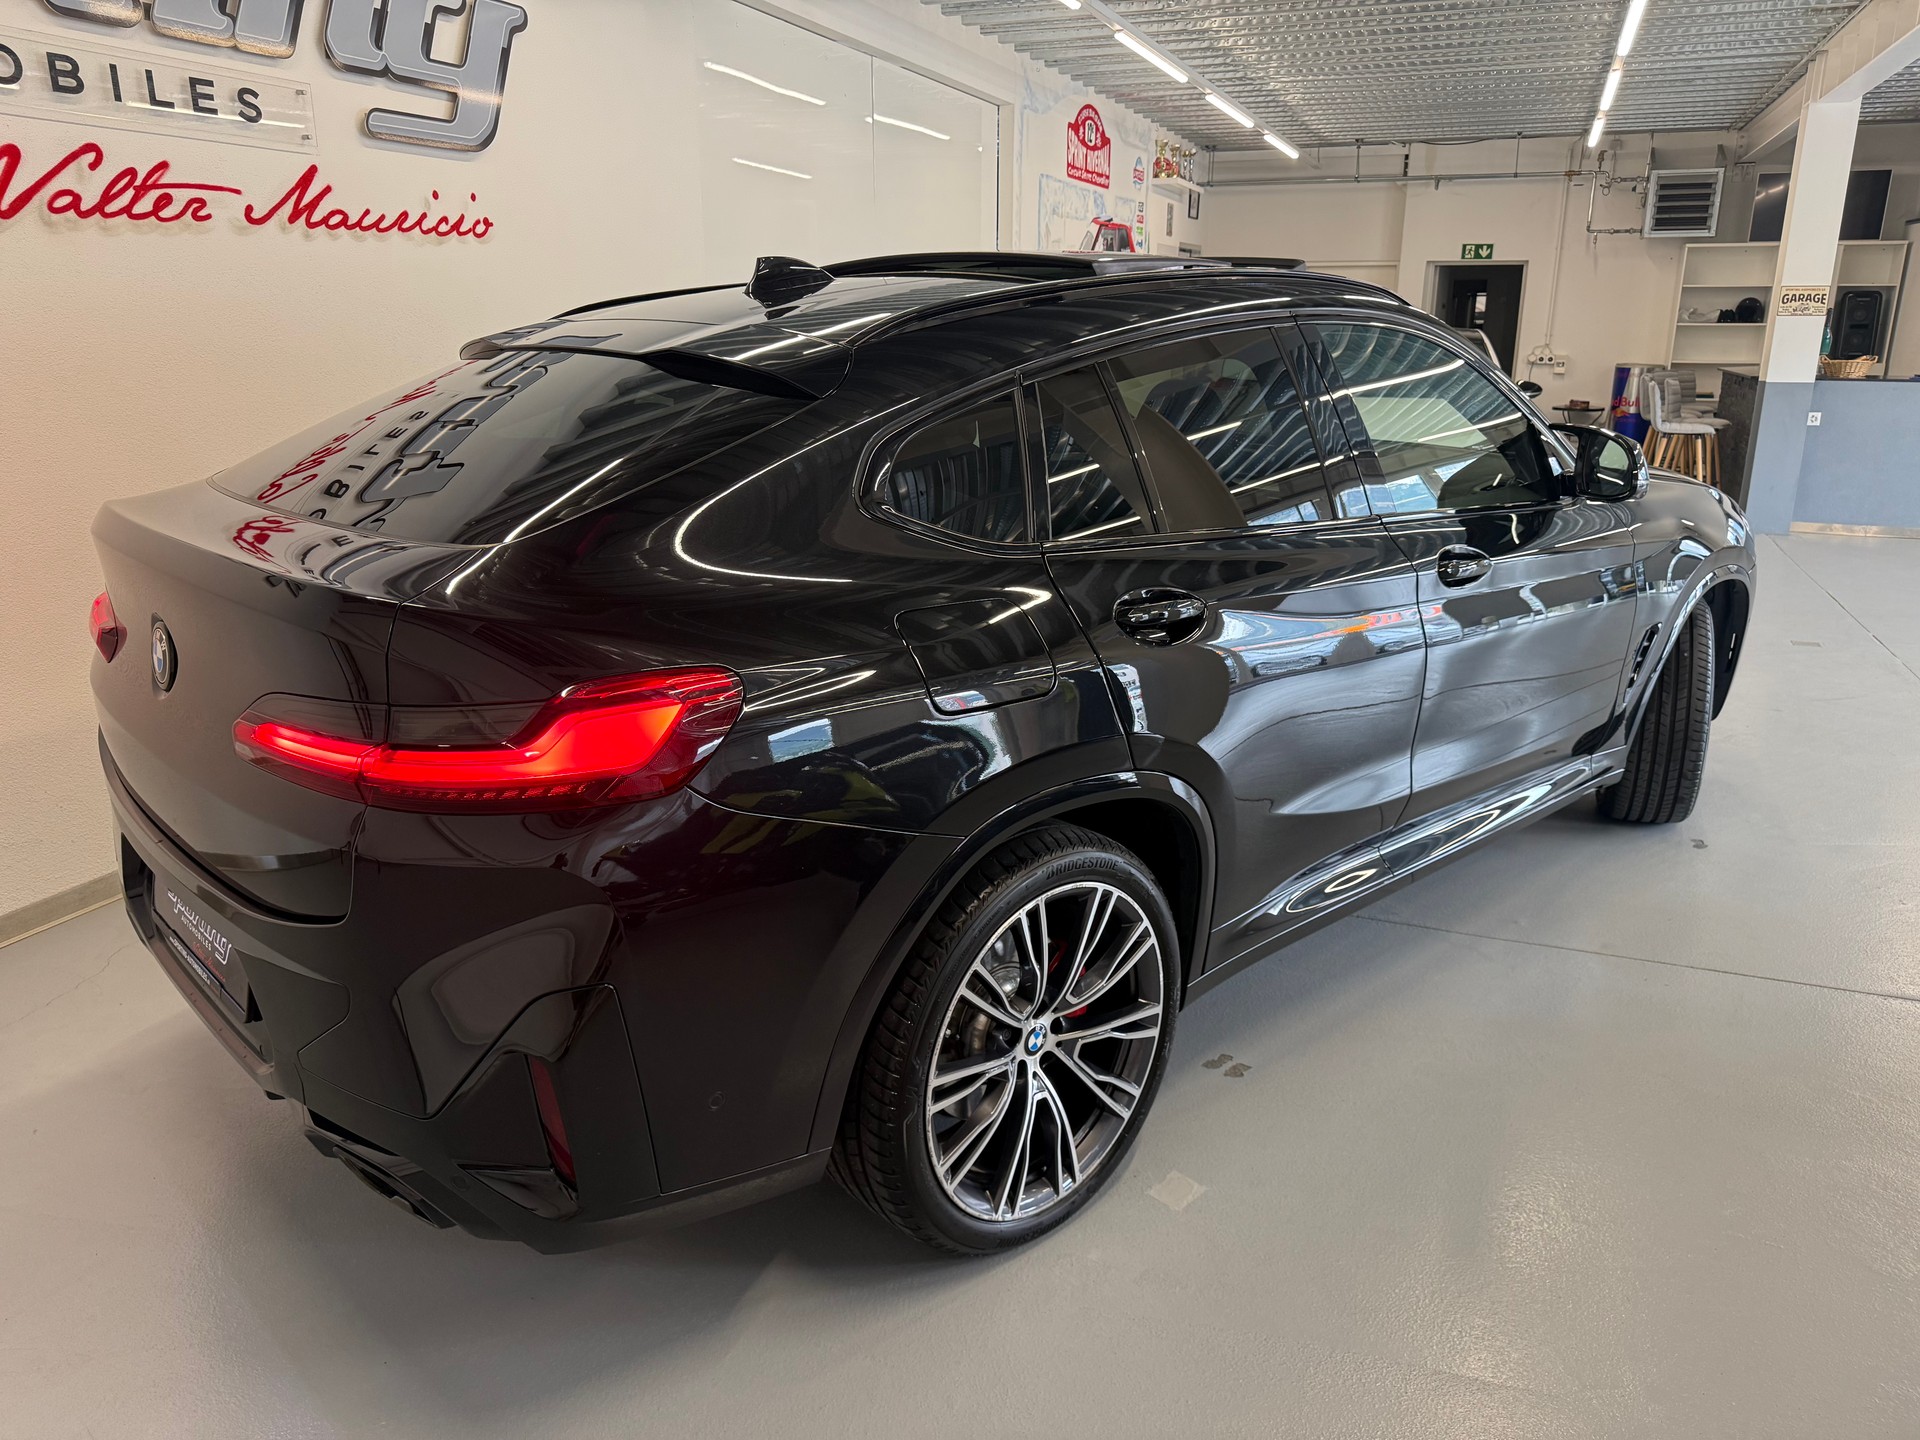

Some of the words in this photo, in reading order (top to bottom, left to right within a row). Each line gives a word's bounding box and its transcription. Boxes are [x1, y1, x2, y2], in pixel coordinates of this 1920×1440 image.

[244, 164, 493, 238] Mauricio
[1781, 293, 1827, 305] GARAGE
[1044, 857, 1119, 880] BRIDGESTONE
[181, 915, 212, 951] AUTOMOBILES
